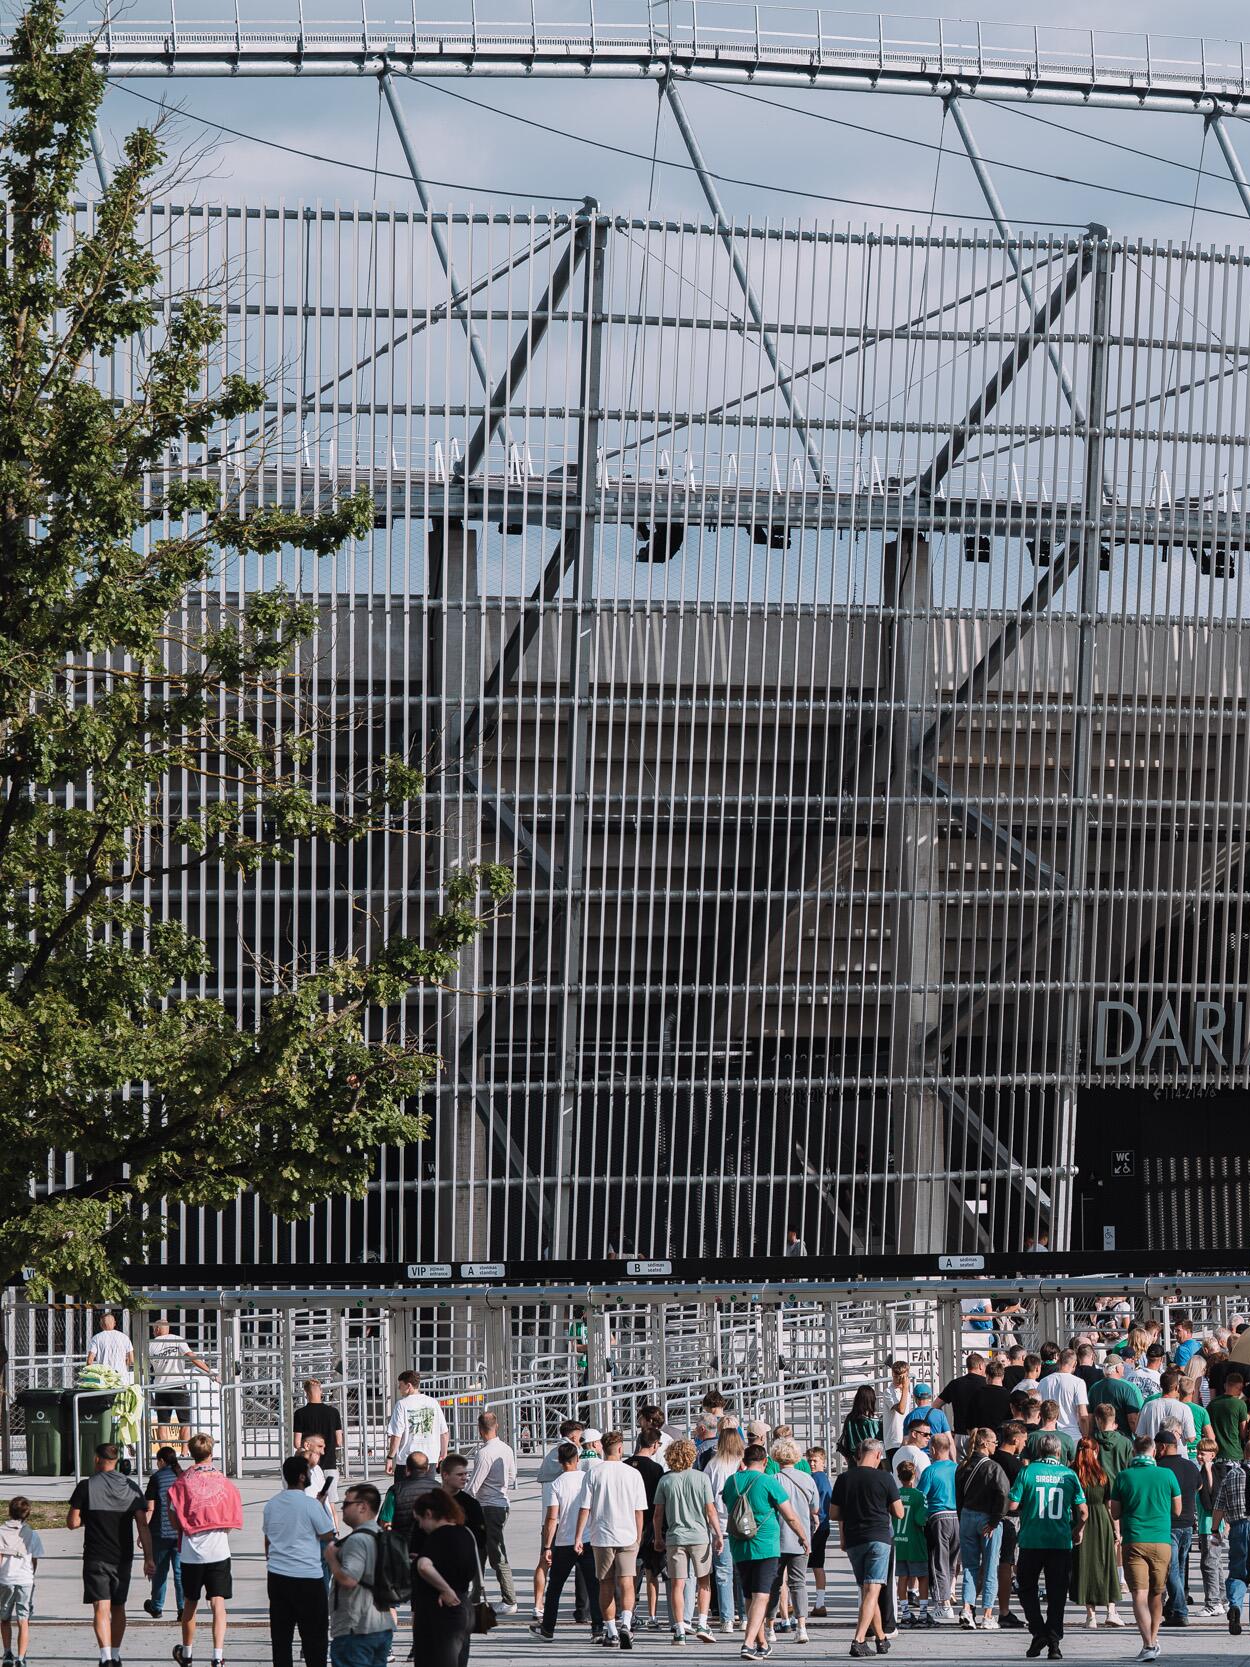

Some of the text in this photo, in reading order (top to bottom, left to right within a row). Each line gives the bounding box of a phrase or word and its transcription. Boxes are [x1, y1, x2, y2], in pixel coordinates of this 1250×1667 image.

[1115, 1152, 1131, 1162] WC
[634, 1264, 641, 1273] B
[945, 1259, 953, 1268] A
[411, 1267, 427, 1277] VIP
[467, 1266, 475, 1276] A
[1036, 1486, 1064, 1519] 10
